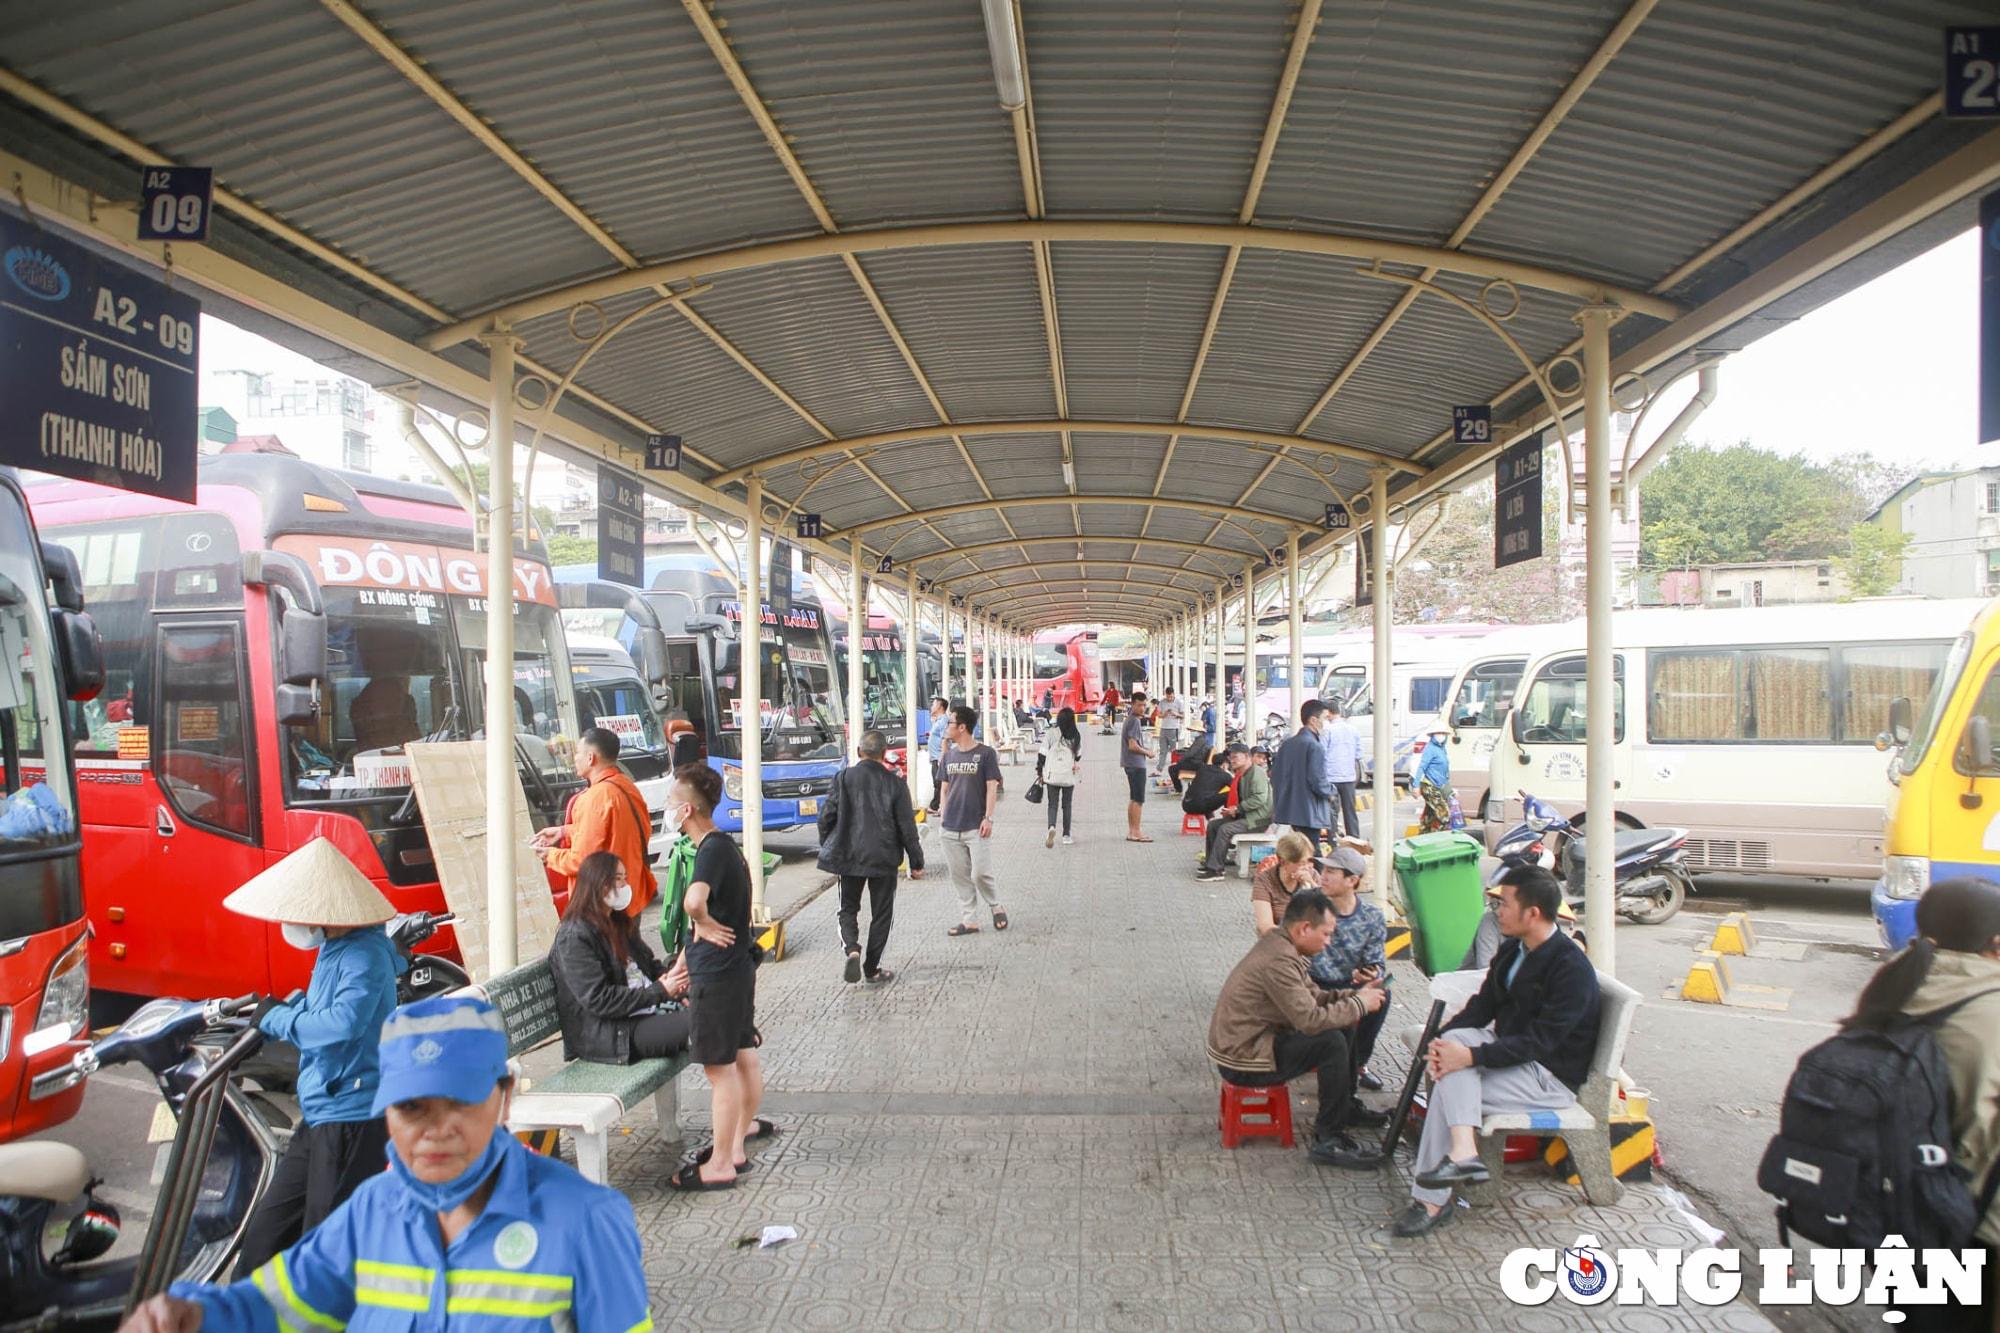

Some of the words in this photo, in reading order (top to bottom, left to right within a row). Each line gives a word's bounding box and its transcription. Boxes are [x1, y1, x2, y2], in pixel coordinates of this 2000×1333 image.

[1952, 33, 1979, 55] A1
[147, 172, 171, 190] A2
[151, 194, 203, 234] 09
[40, 412, 116, 468] (THANH
[1460, 419, 1488, 441] 29
[653, 448, 676, 468] 10
[801, 523, 818, 536] 11
[1329, 512, 1348, 527] 30
[318, 544, 483, 593] ĐÔNG
[359, 589, 375, 605] BX
[377, 589, 408, 607] NÔNG
[467, 598, 482, 611] BX
[374, 766, 401, 786] THANH
[499, 987, 520, 1011] NHÀ
[519, 984, 533, 1003] XE
